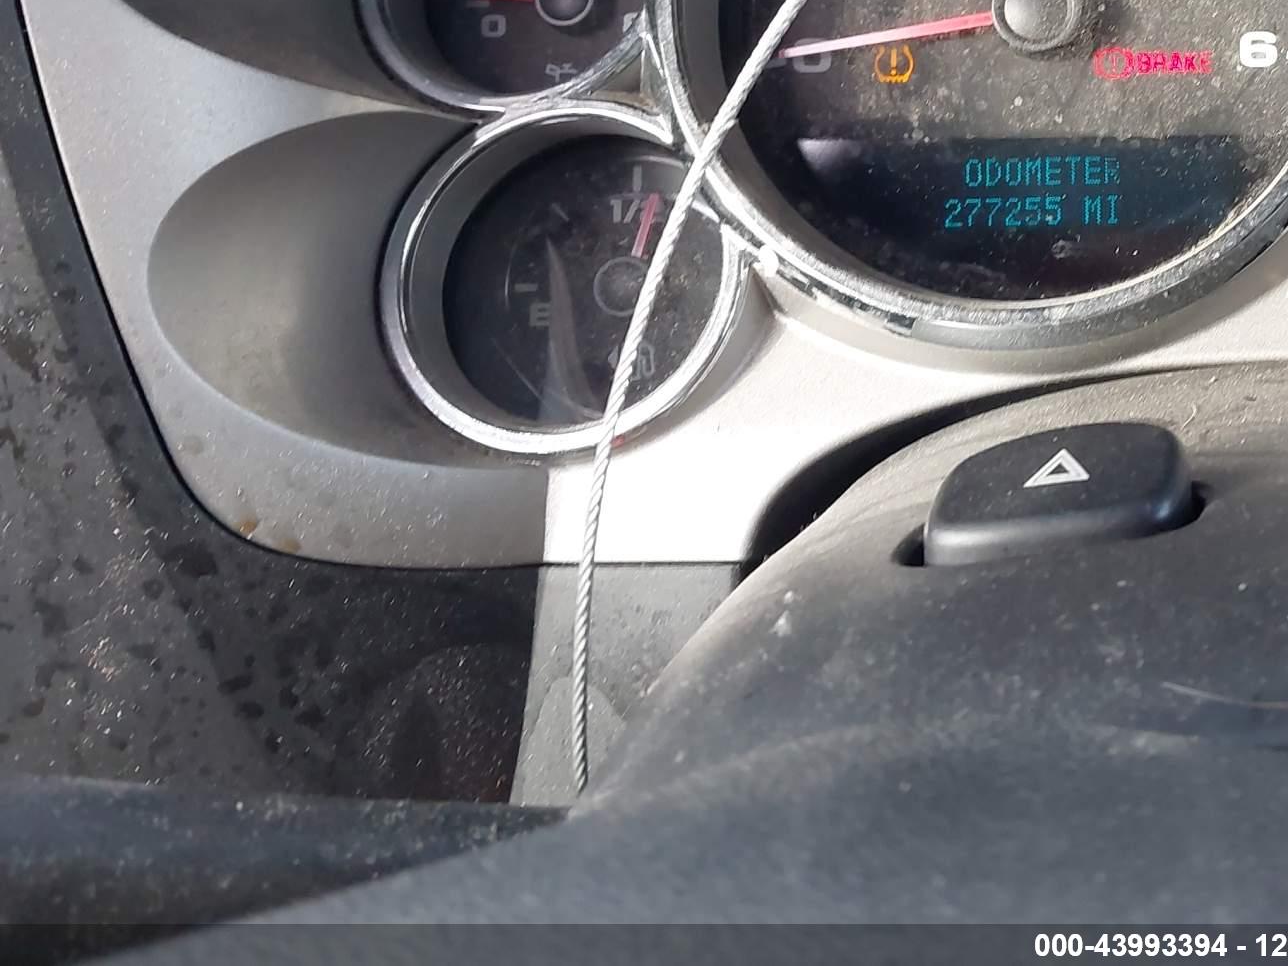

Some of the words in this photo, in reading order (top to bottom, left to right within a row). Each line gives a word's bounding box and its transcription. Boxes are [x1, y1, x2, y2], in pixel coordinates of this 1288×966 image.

[480, 14, 506, 38] 0
[1239, 31, 1278, 67] 6
[965, 156, 1120, 187] ODOMETER
[944, 195, 1063, 228] 277255
[1084, 194, 1119, 225] MI
